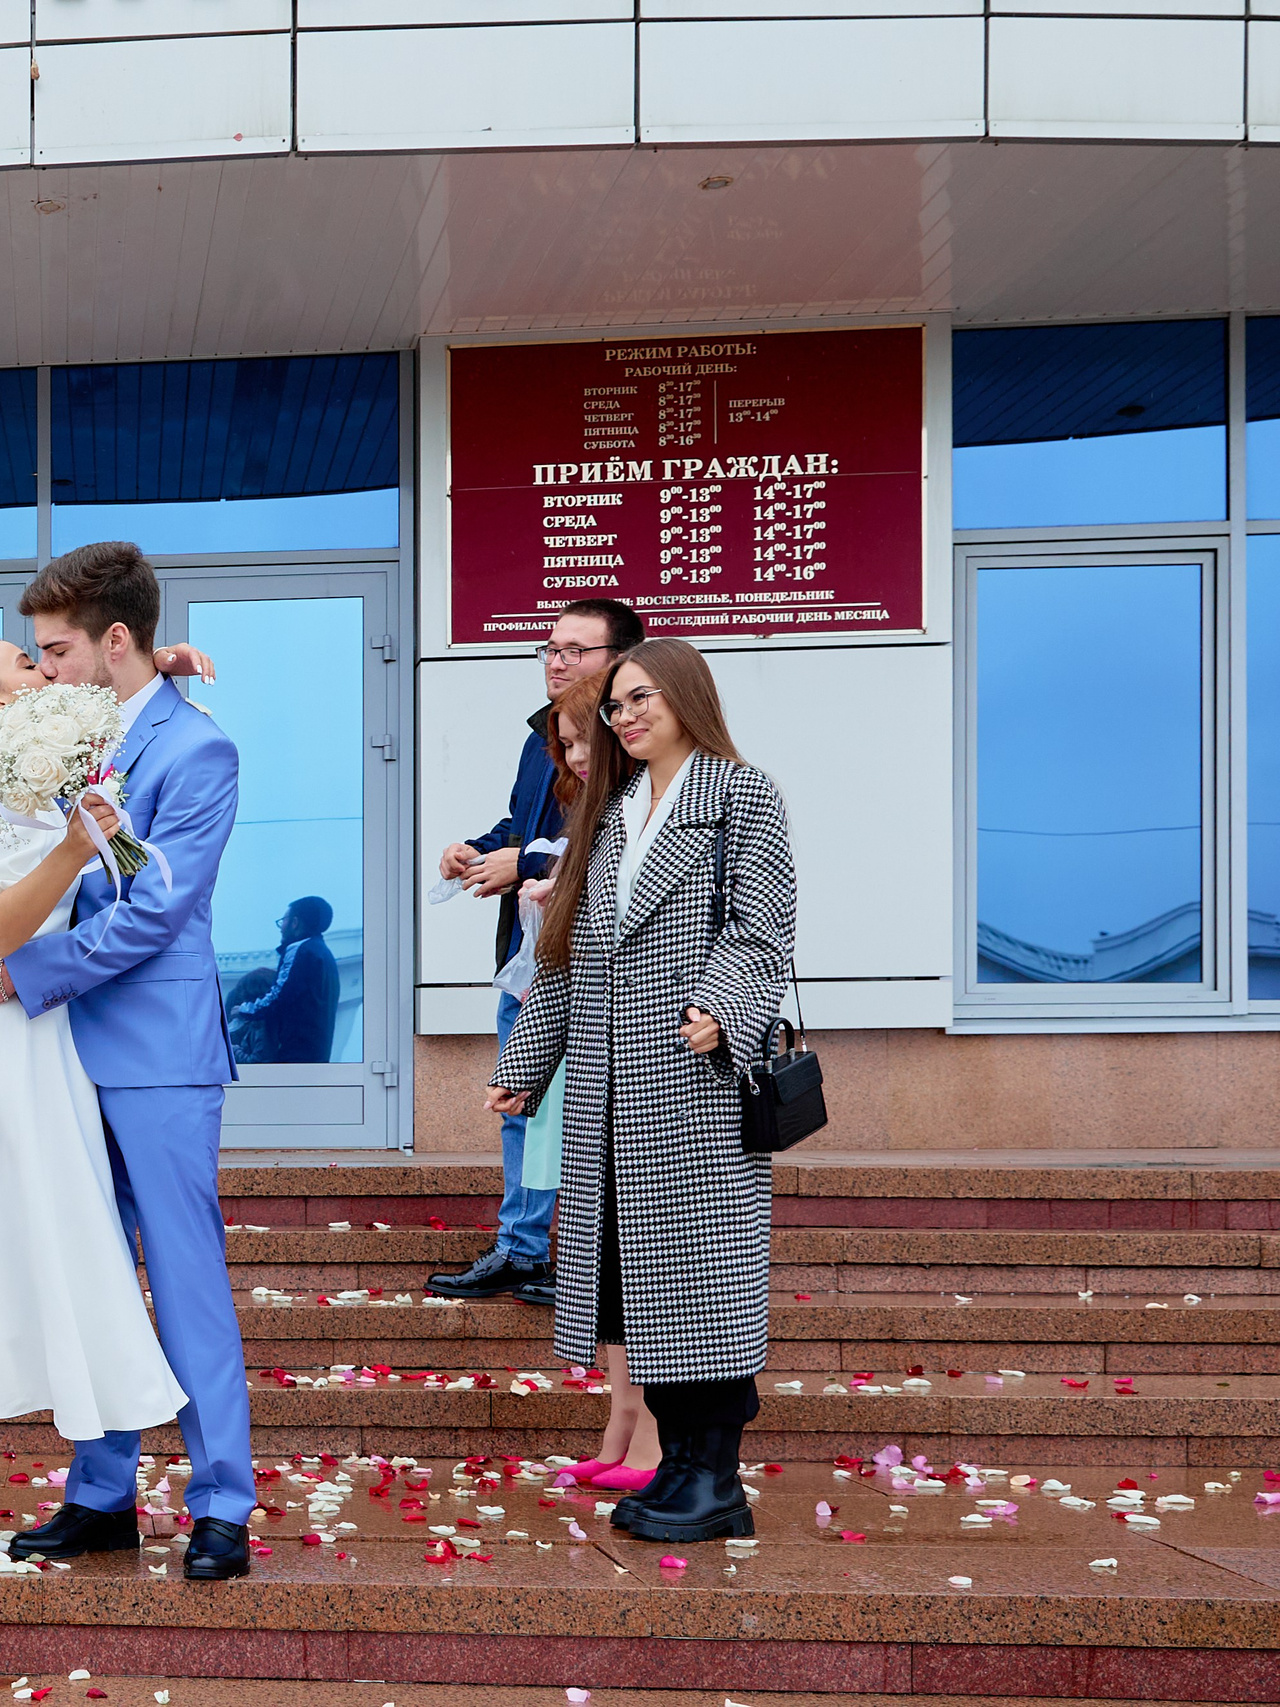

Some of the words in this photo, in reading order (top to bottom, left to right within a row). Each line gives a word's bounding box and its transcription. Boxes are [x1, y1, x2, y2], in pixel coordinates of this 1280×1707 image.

[605, 346, 672, 361] РЕЖИМ
[676, 343, 757, 358] РАБОТЫ:
[624, 363, 692, 377] РАБОЧИЙ
[695, 363, 737, 376] ДЕНЬ:
[584, 386, 638, 396] ВТОРНИК
[583, 400, 620, 410] СРЕДА
[728, 398, 785, 408] ПЕРЕРЫВ
[584, 413, 634, 423] ЧЕТВЕРГ
[584, 426, 639, 436] ПЯТНИЦА
[583, 440, 635, 450] СУББОТА
[532, 456, 654, 485] ПРИЁМ
[662, 453, 839, 482] ГРАЖДАН:
[542, 493, 623, 508] ВТОРНИК
[542, 515, 597, 530] СРЕДА
[543, 534, 617, 548] ЧЕТВЕРГ
[543, 554, 624, 569] ПЯТНИЦА
[542, 574, 619, 589] СУББОТА
[536, 600, 577, 609] ВЫХО
[636, 593, 733, 606] ВОСКРЕСЕНЬЕ,
[735, 590, 835, 603] ПОНЕДЕЛЬНИК
[648, 613, 729, 627] ПОСЛЕДНИЙ
[796, 611, 832, 623] ДЕНЬ
[834, 609, 889, 621] МЕСЯЦА
